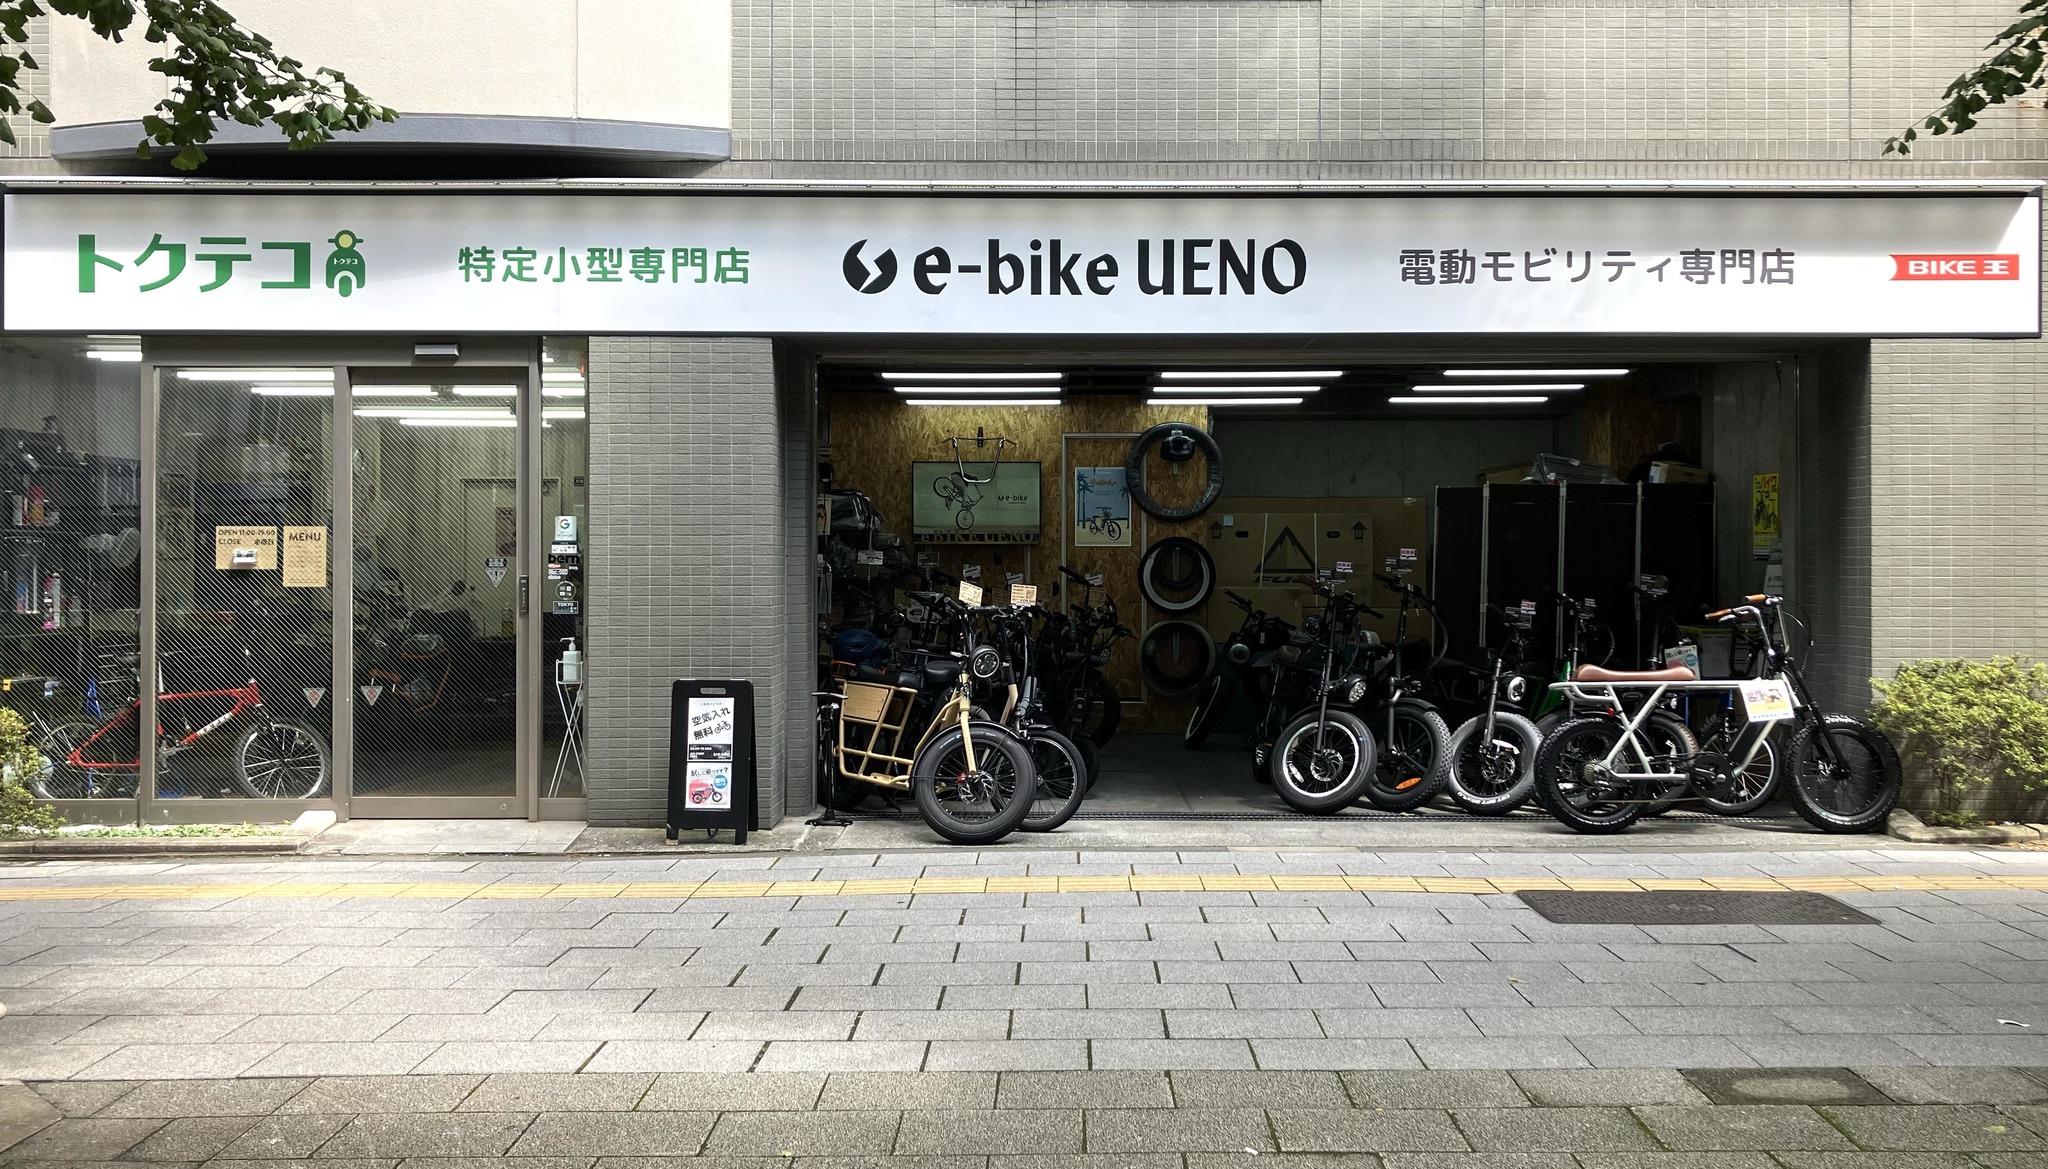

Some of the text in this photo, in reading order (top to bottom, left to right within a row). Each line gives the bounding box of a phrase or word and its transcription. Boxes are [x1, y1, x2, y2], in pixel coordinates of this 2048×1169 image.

[78, 233, 311, 293] トクテコ
[333, 257, 358, 265] トクテコ
[458, 245, 750, 285] 特定小型専門店
[914, 239, 1307, 295] e-bike UENO
[1399, 248, 1796, 285] 電動モビリティ専門店
[1908, 260, 2010, 275] BIKE 王
[288, 532, 321, 541] MENU
[984, 529, 1036, 542] UENO
[548, 553, 580, 564] bern
[692, 707, 731, 726] 空気入れ
[694, 726, 713, 740] 無料
